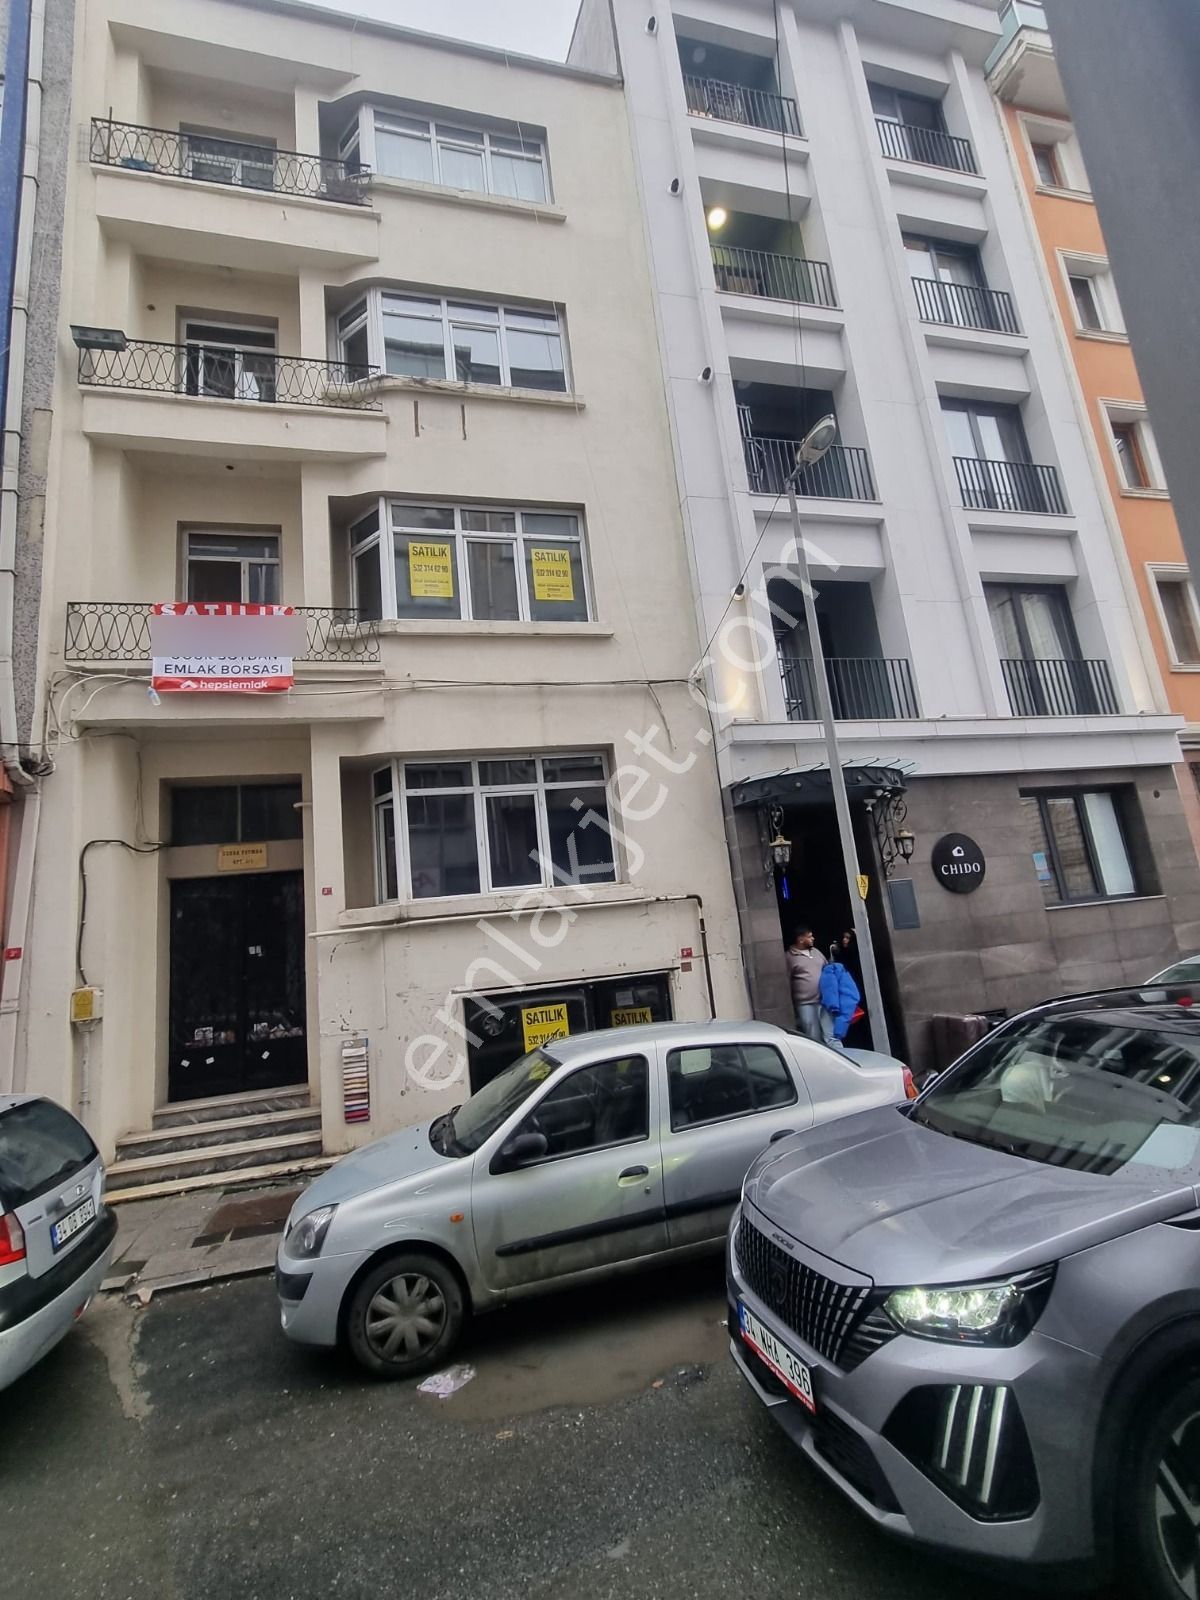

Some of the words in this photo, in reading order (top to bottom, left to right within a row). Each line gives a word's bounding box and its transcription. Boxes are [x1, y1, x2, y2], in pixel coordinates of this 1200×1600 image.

[412, 546, 447, 557] SATILIK
[534, 552, 567, 563] SATILIK
[164, 664, 217, 675] EMLAK
[221, 664, 283, 675] BORSASI
[941, 862, 981, 876] CHIDO
[526, 1007, 564, 1025] SATILIK
[614, 1010, 649, 1026] SATILIK
[528, 1034, 539, 1046] 532
[743, 1309, 756, 1340] 34
[760, 1328, 782, 1368] NHA
[786, 1352, 811, 1396] 396
